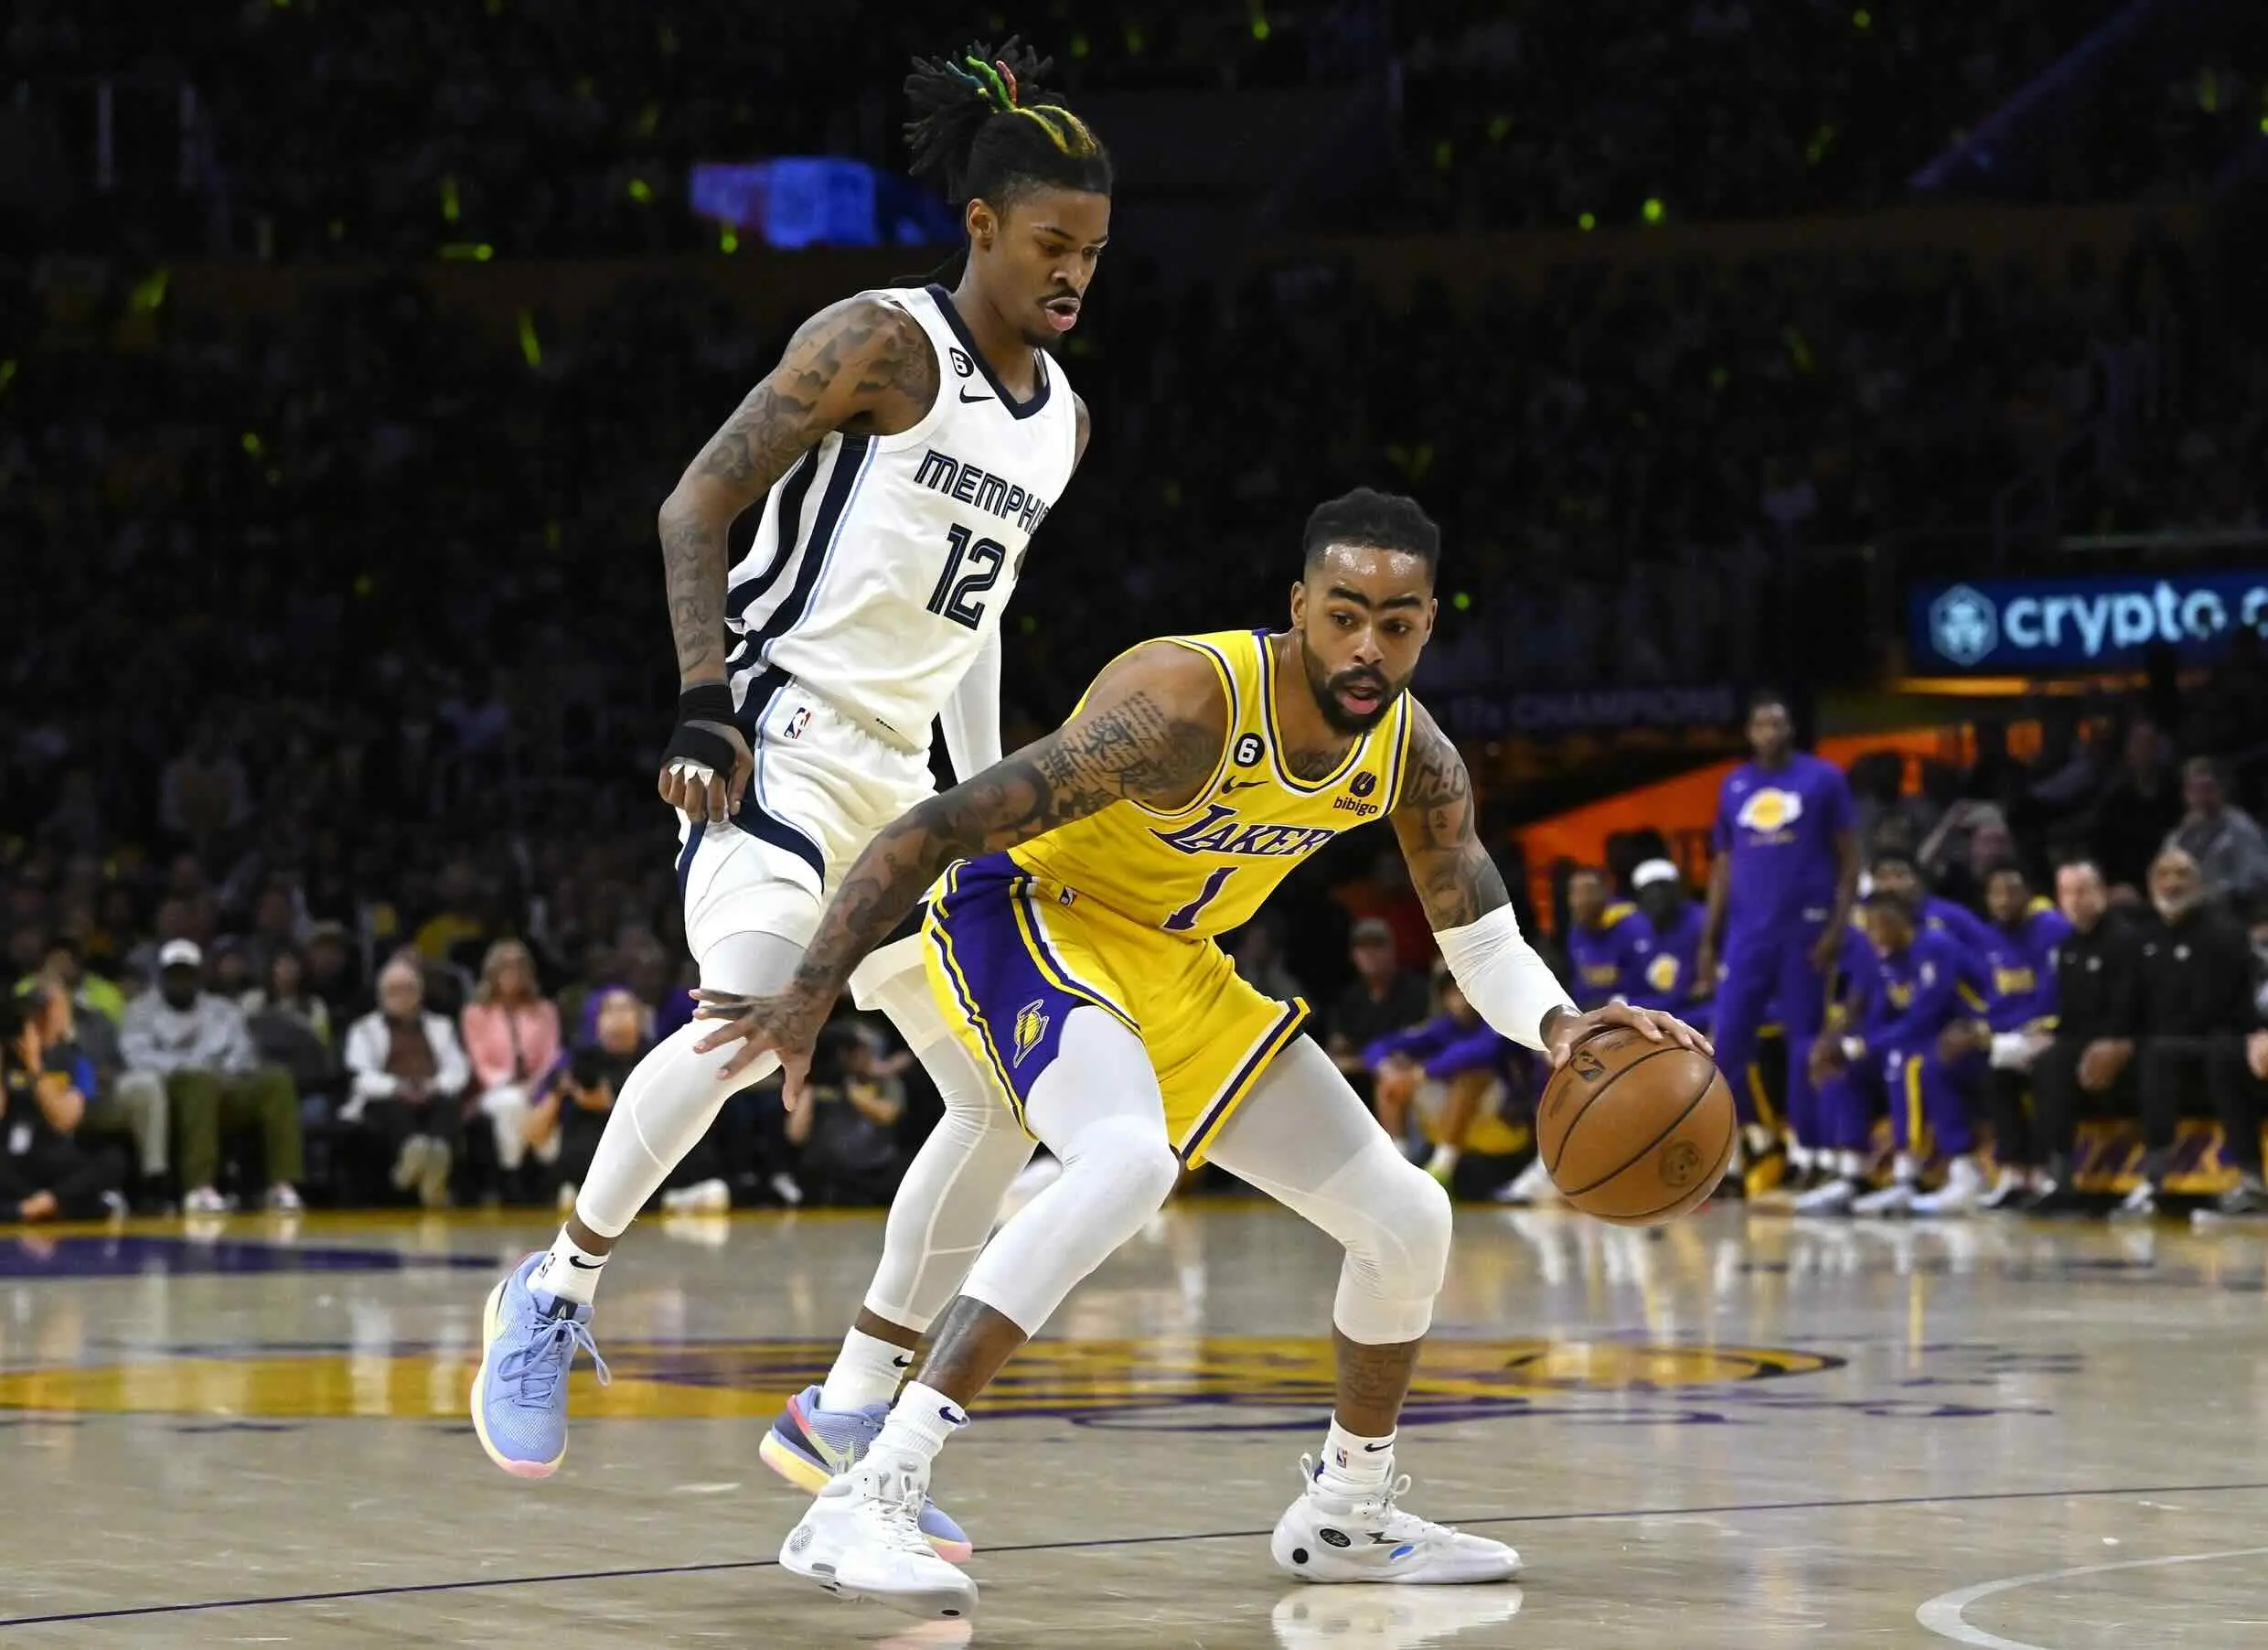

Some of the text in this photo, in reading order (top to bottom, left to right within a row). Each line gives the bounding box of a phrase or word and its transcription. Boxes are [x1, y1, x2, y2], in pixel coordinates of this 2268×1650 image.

[925, 522, 1006, 631] 12
[1237, 738, 1258, 764] 6
[1332, 797, 1378, 817] bibigo
[1161, 866, 1238, 930] 1
